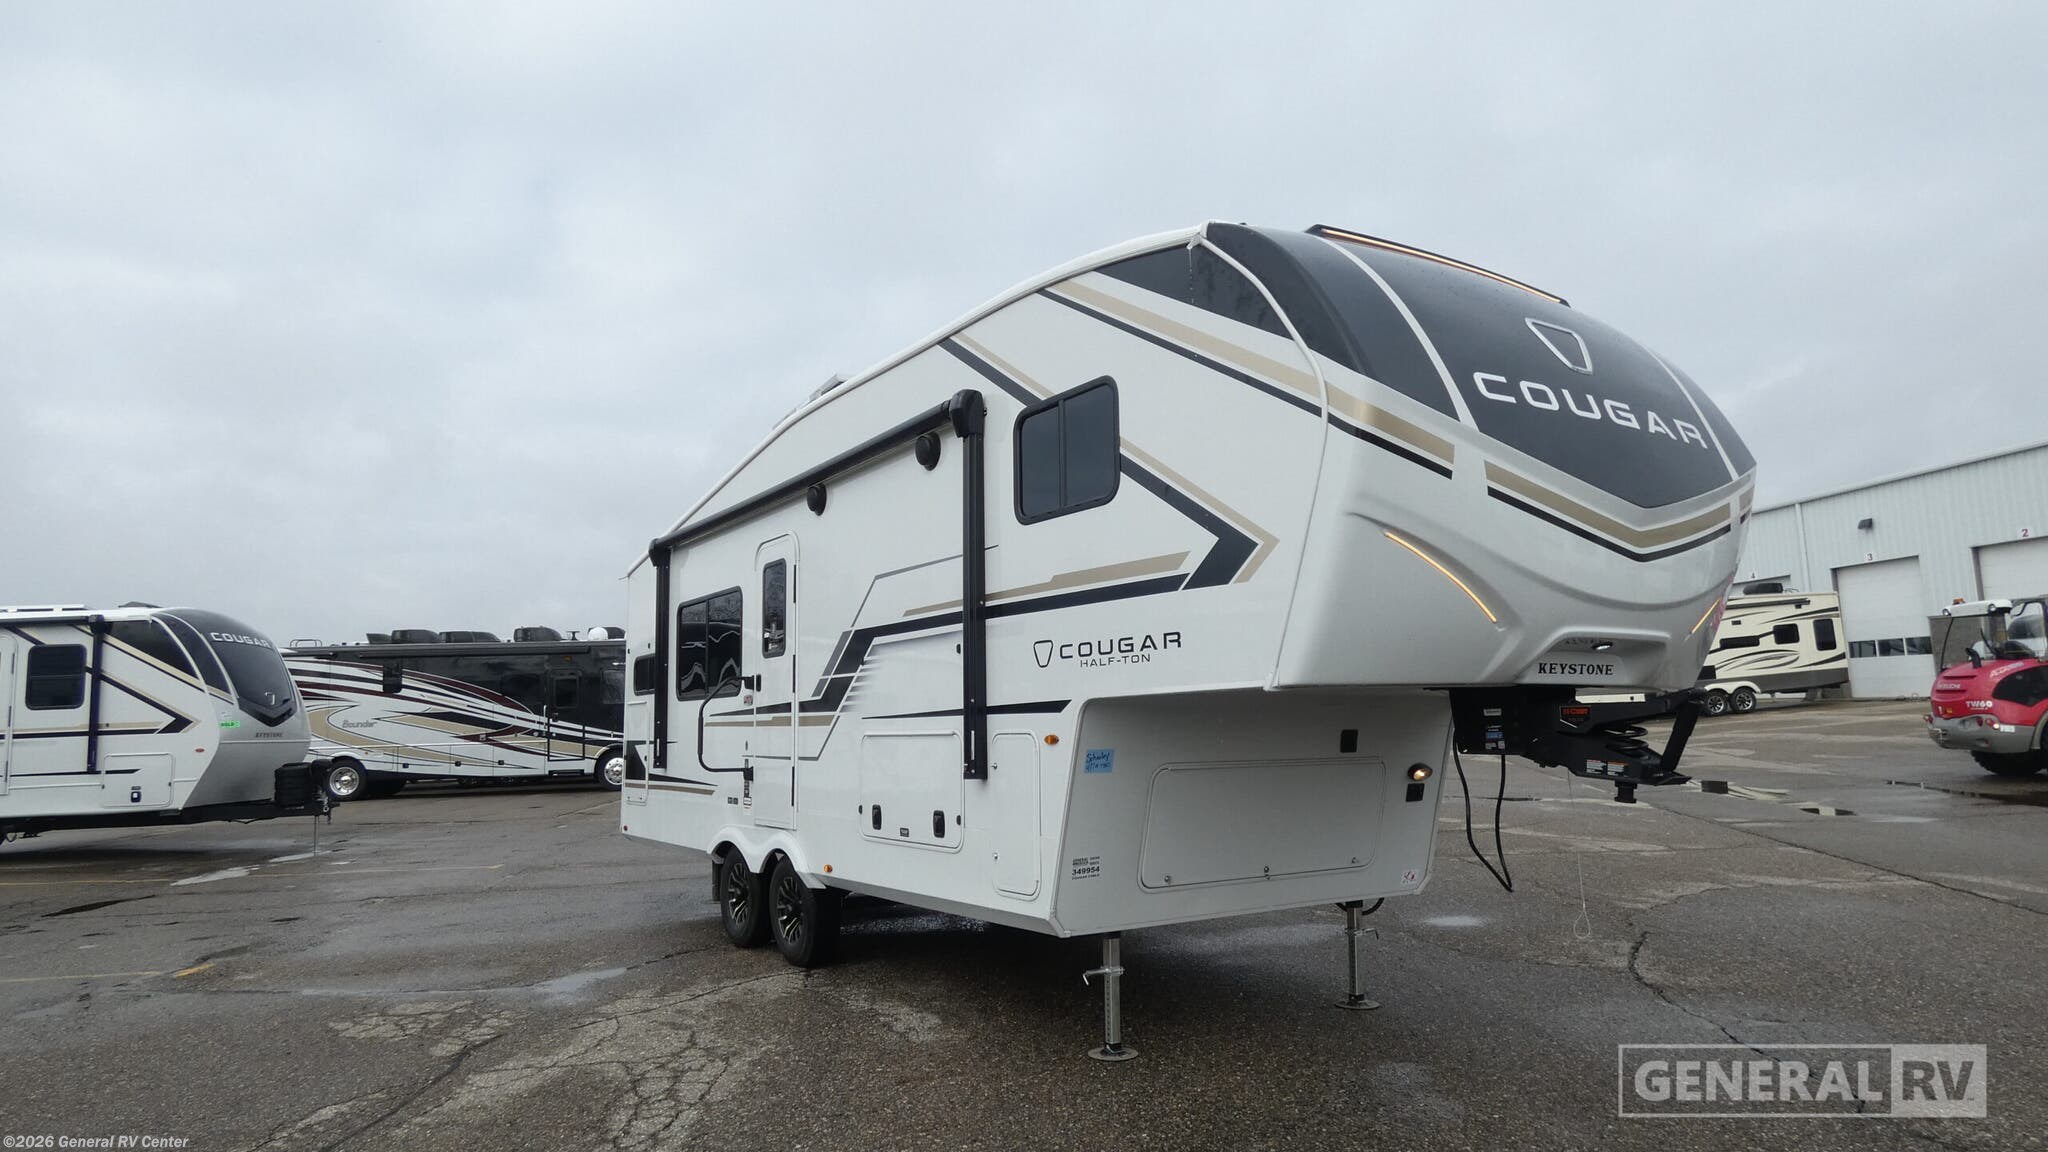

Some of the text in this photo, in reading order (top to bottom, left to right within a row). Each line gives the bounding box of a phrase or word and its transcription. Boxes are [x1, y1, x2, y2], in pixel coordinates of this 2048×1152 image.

[1473, 372, 1708, 449] COUGAR
[2022, 529, 2029, 537] 2
[1867, 553, 1873, 561] 3
[210, 632, 272, 648] COUGAR
[1059, 632, 1181, 659] COUGAR
[1080, 654, 1151, 667] HALF-TON
[1538, 663, 1614, 675] KEYSTONE
[1072, 866, 1100, 875] 349954
